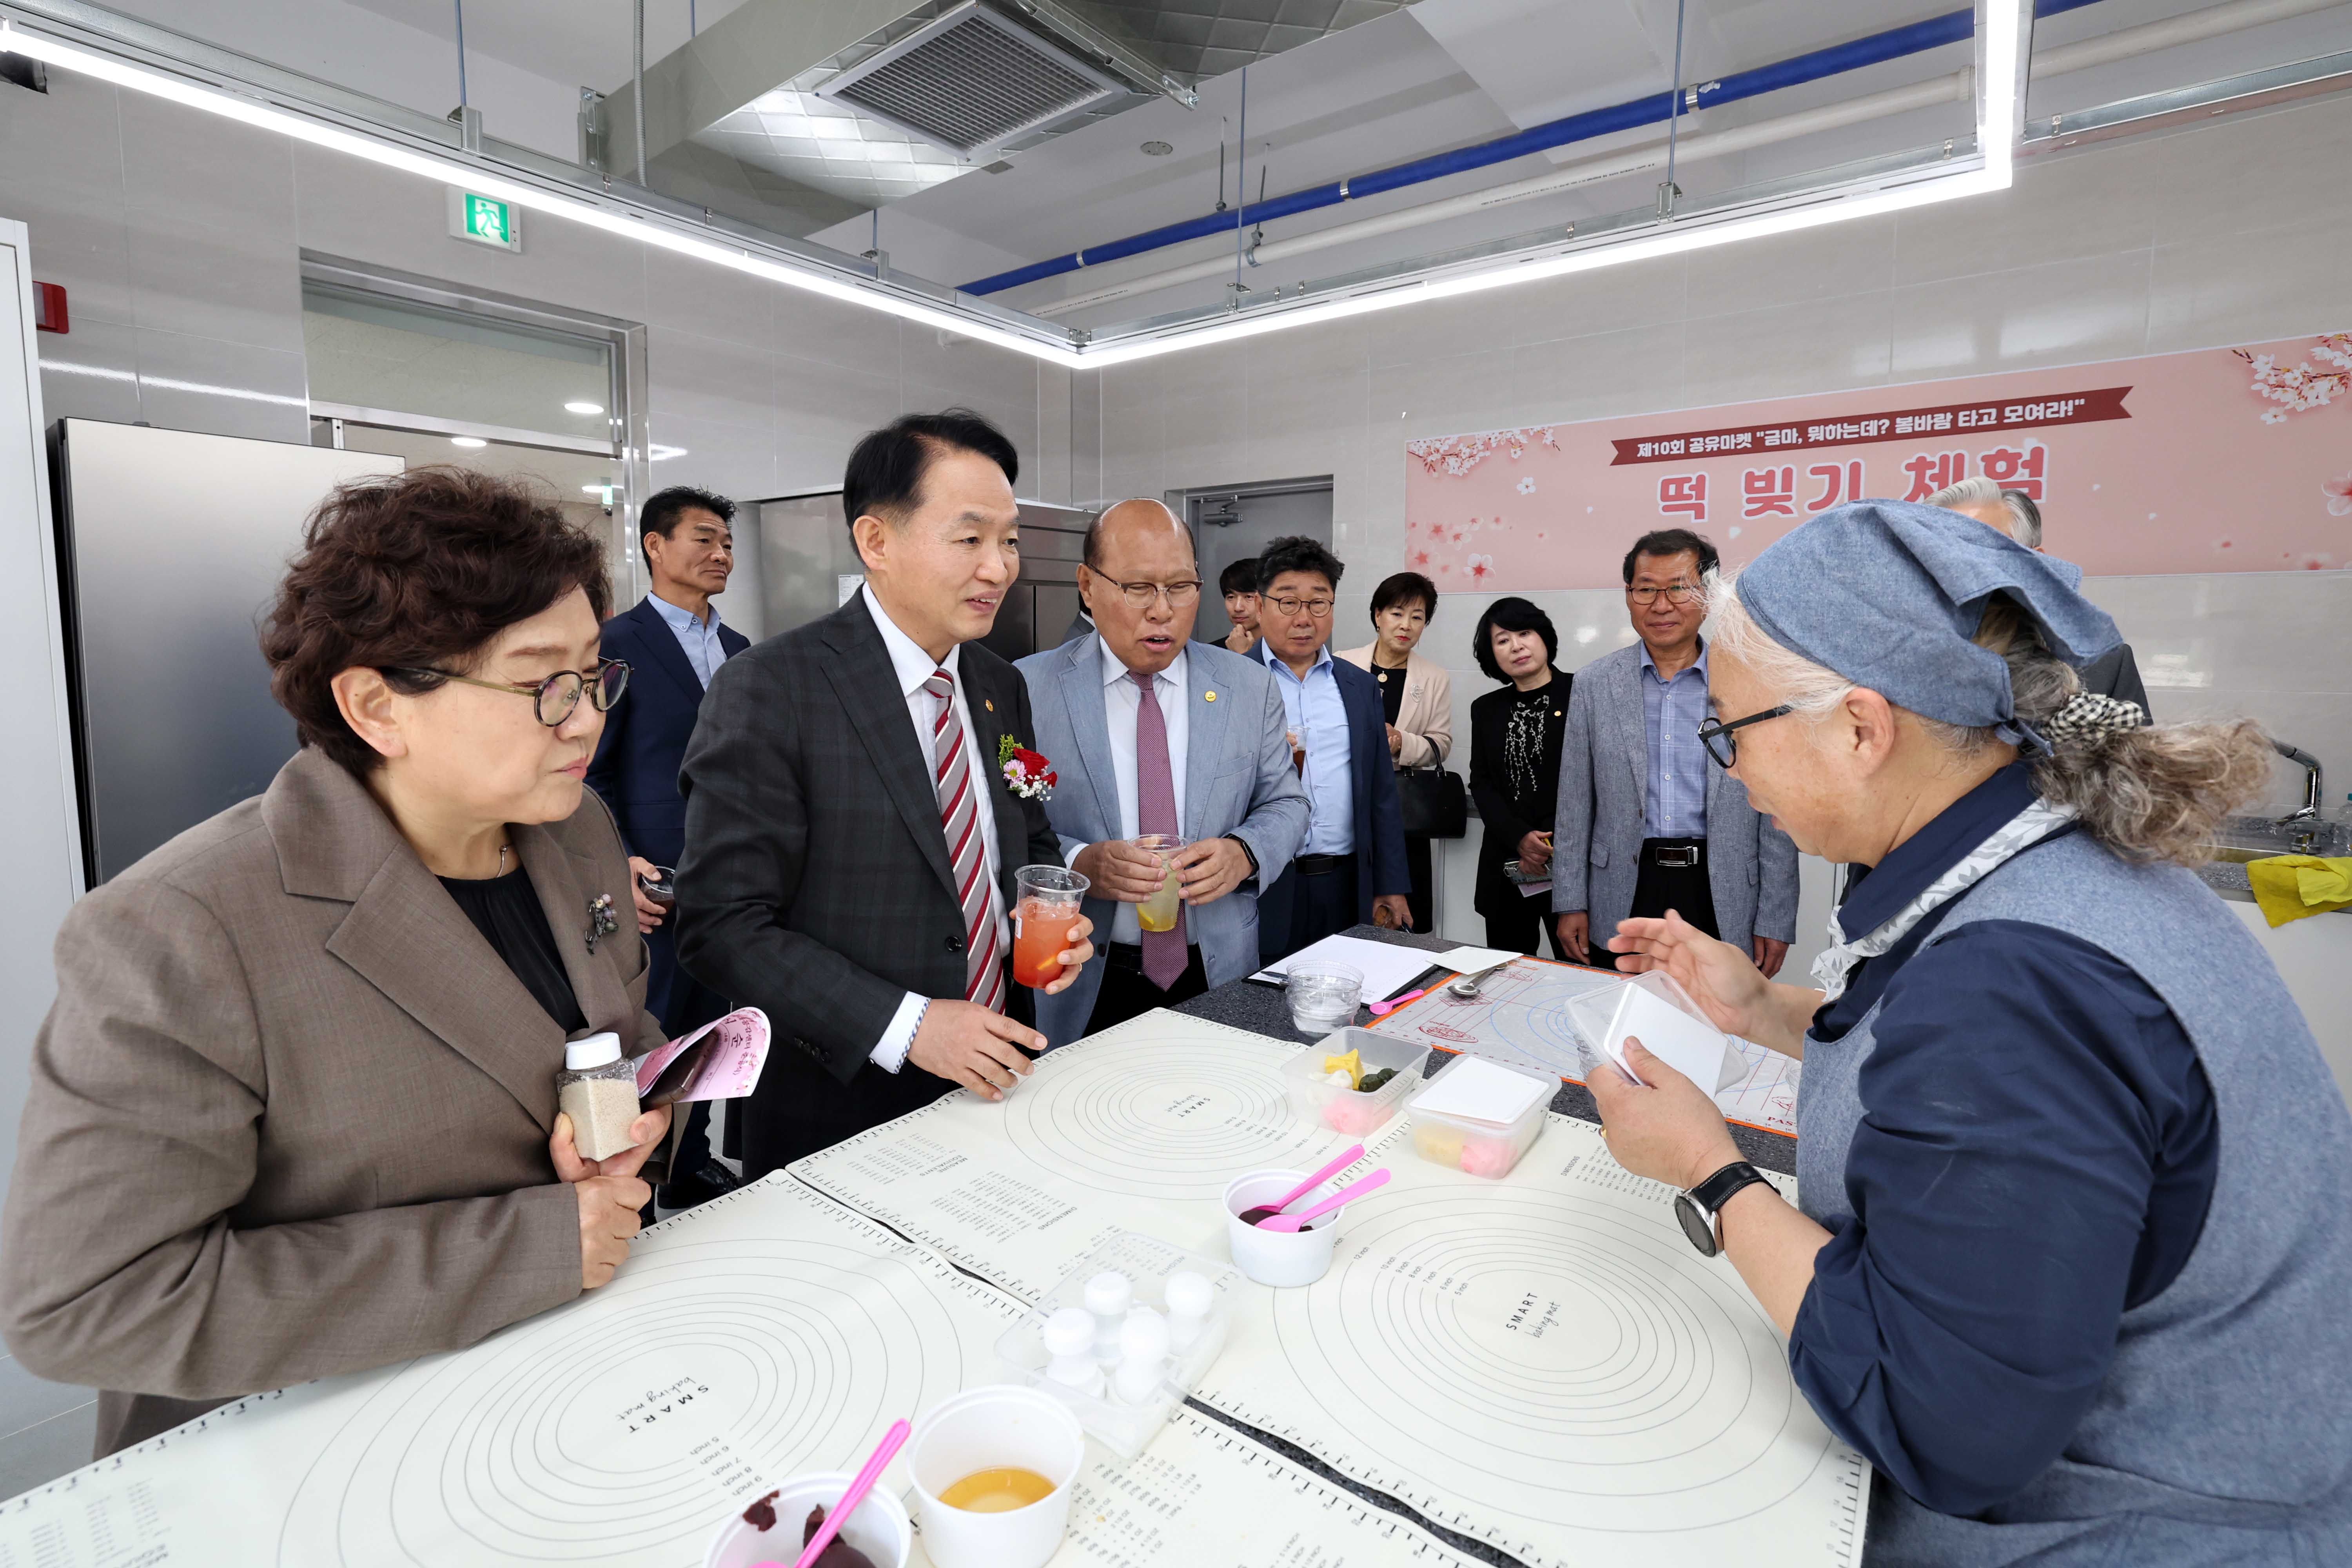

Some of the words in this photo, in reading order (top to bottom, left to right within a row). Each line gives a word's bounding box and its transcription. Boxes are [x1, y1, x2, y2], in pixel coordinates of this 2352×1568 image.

[1637, 439, 1685, 457] 제10회
[1689, 432, 1752, 454] 공유마켓
[1756, 428, 1803, 446] "금마,
[1808, 418, 1891, 443] 뭐하는데?
[1895, 412, 1954, 434] 봄바람
[1958, 408, 1998, 428] 타고
[2002, 398, 2085, 424] 모여라!"
[1658, 472, 1708, 522] 떡
[1742, 458, 1864, 519] 빚기
[1901, 443, 2048, 503] 체험
[1177, 1097, 1210, 1118] SMART
[1767, 1116, 1797, 1127] PAS
[919, 1155, 963, 1177] EQUIVALENTS
[939, 1157, 968, 1173] MEASURE
[1561, 1156, 1580, 1176] DIMENSIONS
[1038, 1206, 1078, 1231] DIMENSIONS
[1354, 1252, 1362, 1261] 12
[1359, 1247, 1370, 1256] inch
[1157, 1256, 1186, 1277] WEIGHTS
[1380, 1261, 1388, 1270] 10
[1386, 1256, 1397, 1267] inch
[1400, 1260, 1410, 1271] inch
[1413, 1265, 1423, 1276] inch
[1427, 1270, 1437, 1281] inch
[1445, 1277, 1454, 1287] inch
[1459, 1282, 1469, 1293] inch
[1506, 1292, 1538, 1330] SMART
[1524, 1314, 1559, 1339] baking
[1548, 1301, 1561, 1317] mat
[645, 1376, 697, 1403] baking
[616, 1402, 645, 1421] mat
[629, 1385, 709, 1433] SMART
[690, 1441, 710, 1455] inch
[699, 1450, 721, 1465] inch
[711, 1461, 732, 1477] inch
[722, 1471, 744, 1487] inch
[731, 1481, 753, 1497] inch
